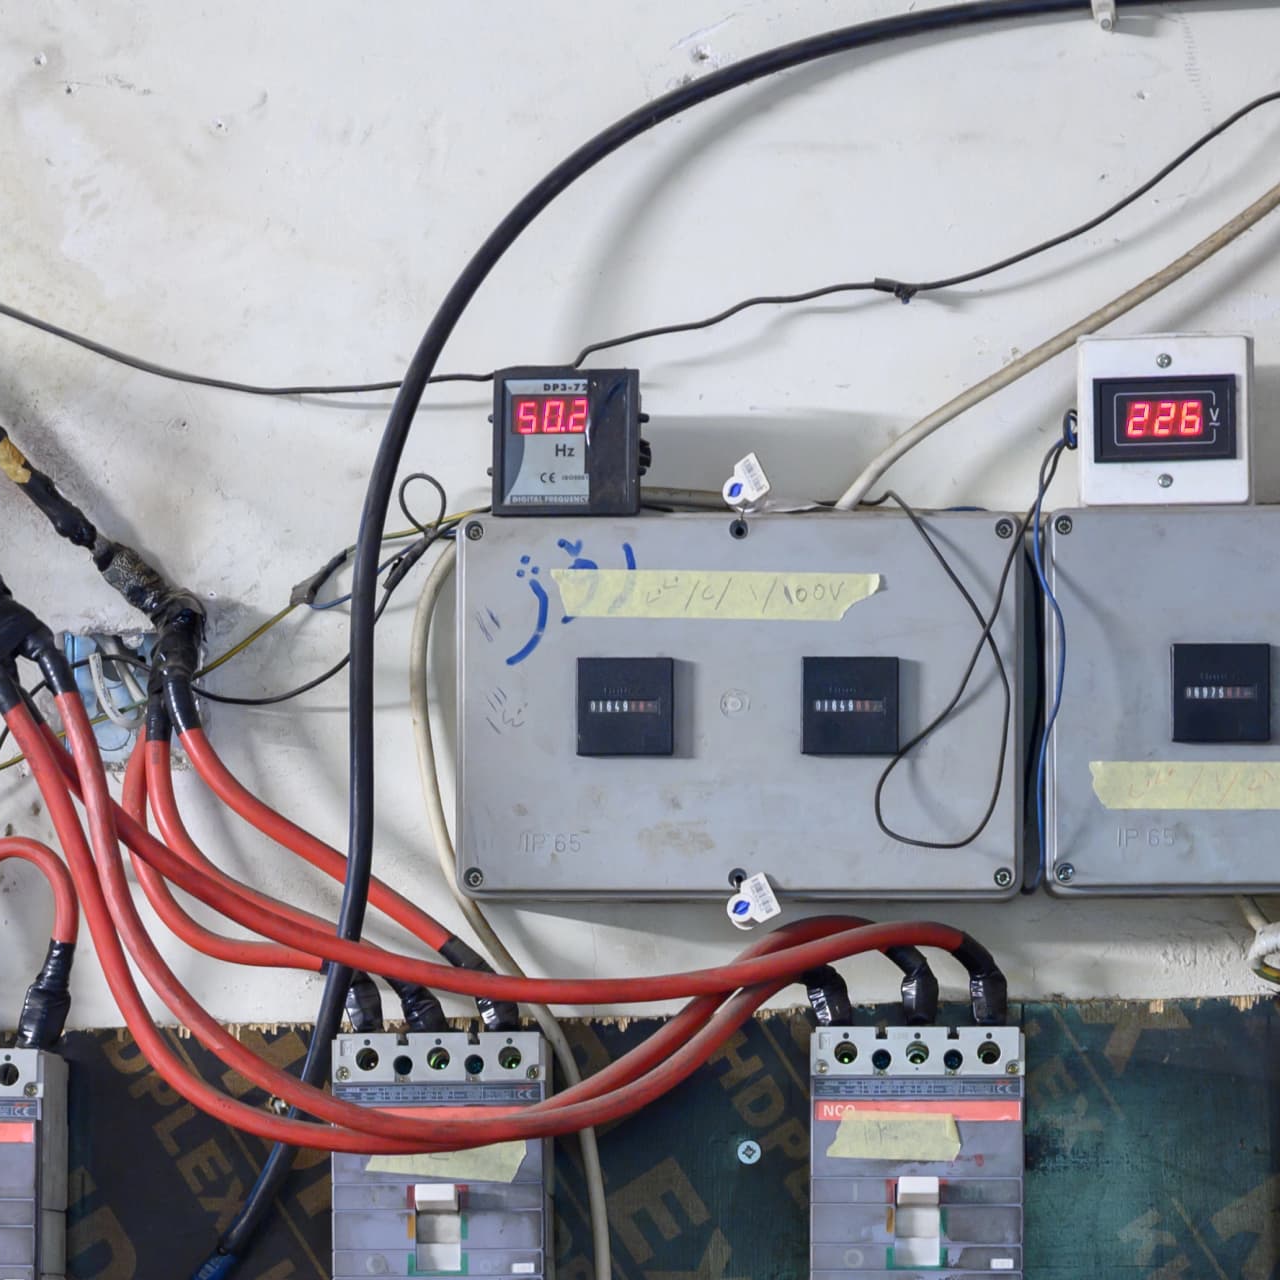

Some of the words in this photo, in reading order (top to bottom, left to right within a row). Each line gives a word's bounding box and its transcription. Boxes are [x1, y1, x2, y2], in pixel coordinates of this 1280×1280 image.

[518, 398, 588, 435] 50.2
[1127, 401, 1203, 438] 226
[555, 443, 575, 457] Hz
